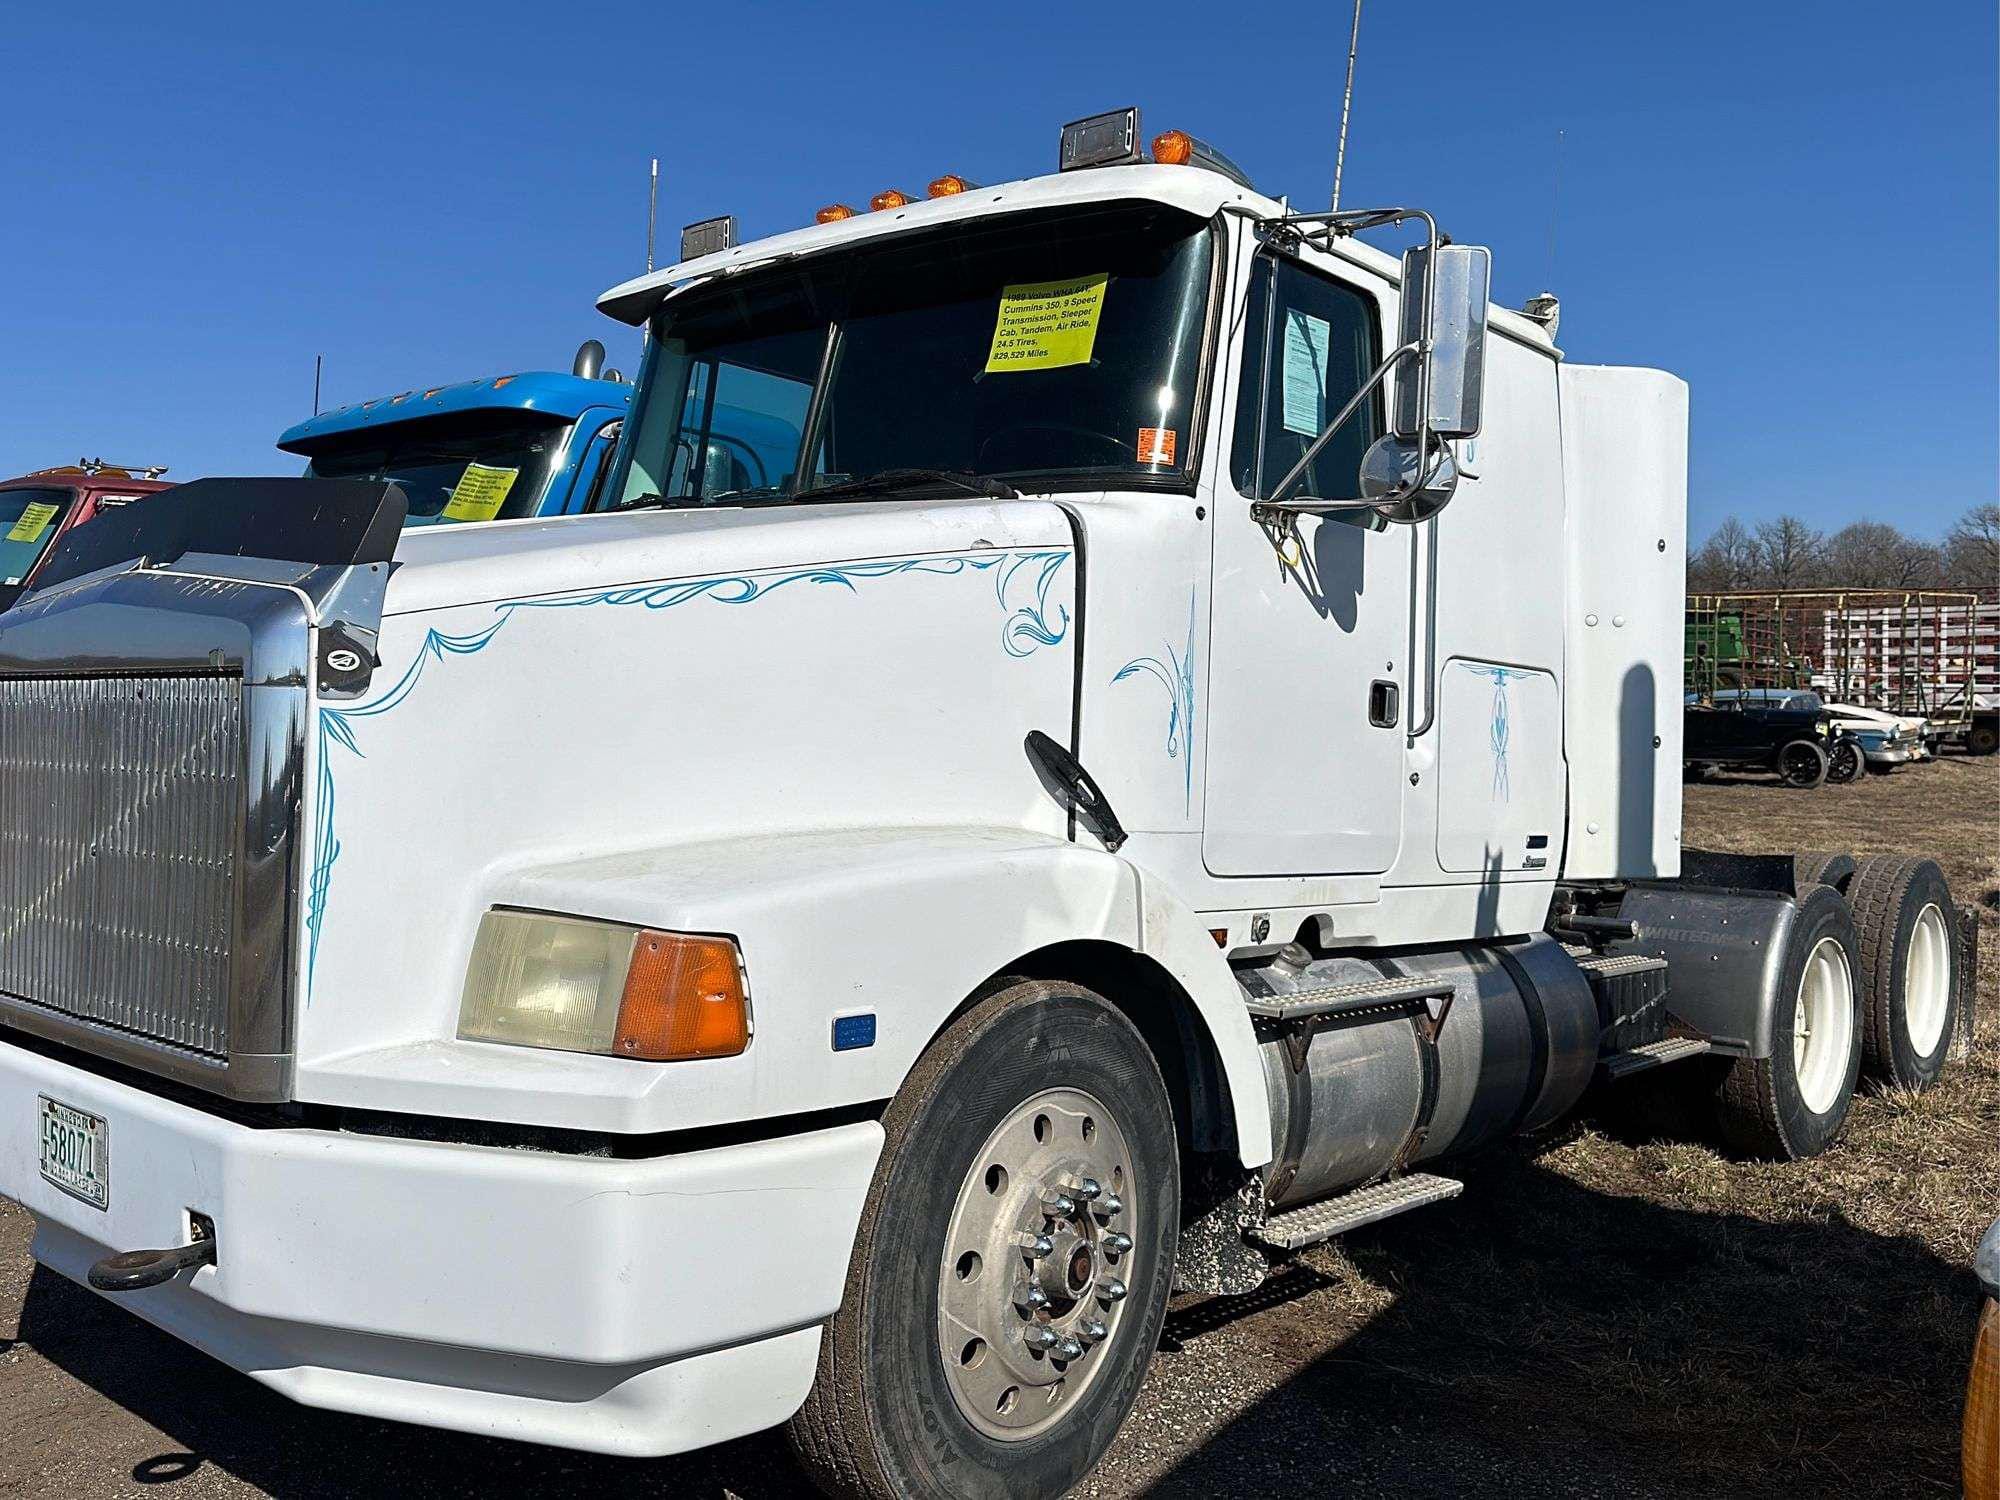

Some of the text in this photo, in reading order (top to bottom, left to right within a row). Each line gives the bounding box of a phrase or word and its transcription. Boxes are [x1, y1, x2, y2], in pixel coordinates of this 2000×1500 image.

[1029, 290, 1051, 299] Volvo
[1004, 295, 1097, 314] Cummins 350, 9 Speed
[1002, 308, 1092, 326] Transmission, Sleeper
[1000, 319, 1091, 337] Cab, Tandem, Air Ride,
[997, 339, 1038, 349] 24.5 Tires,
[993, 350, 1025, 360] 829,529
[51, 1119, 95, 1180] 58071
